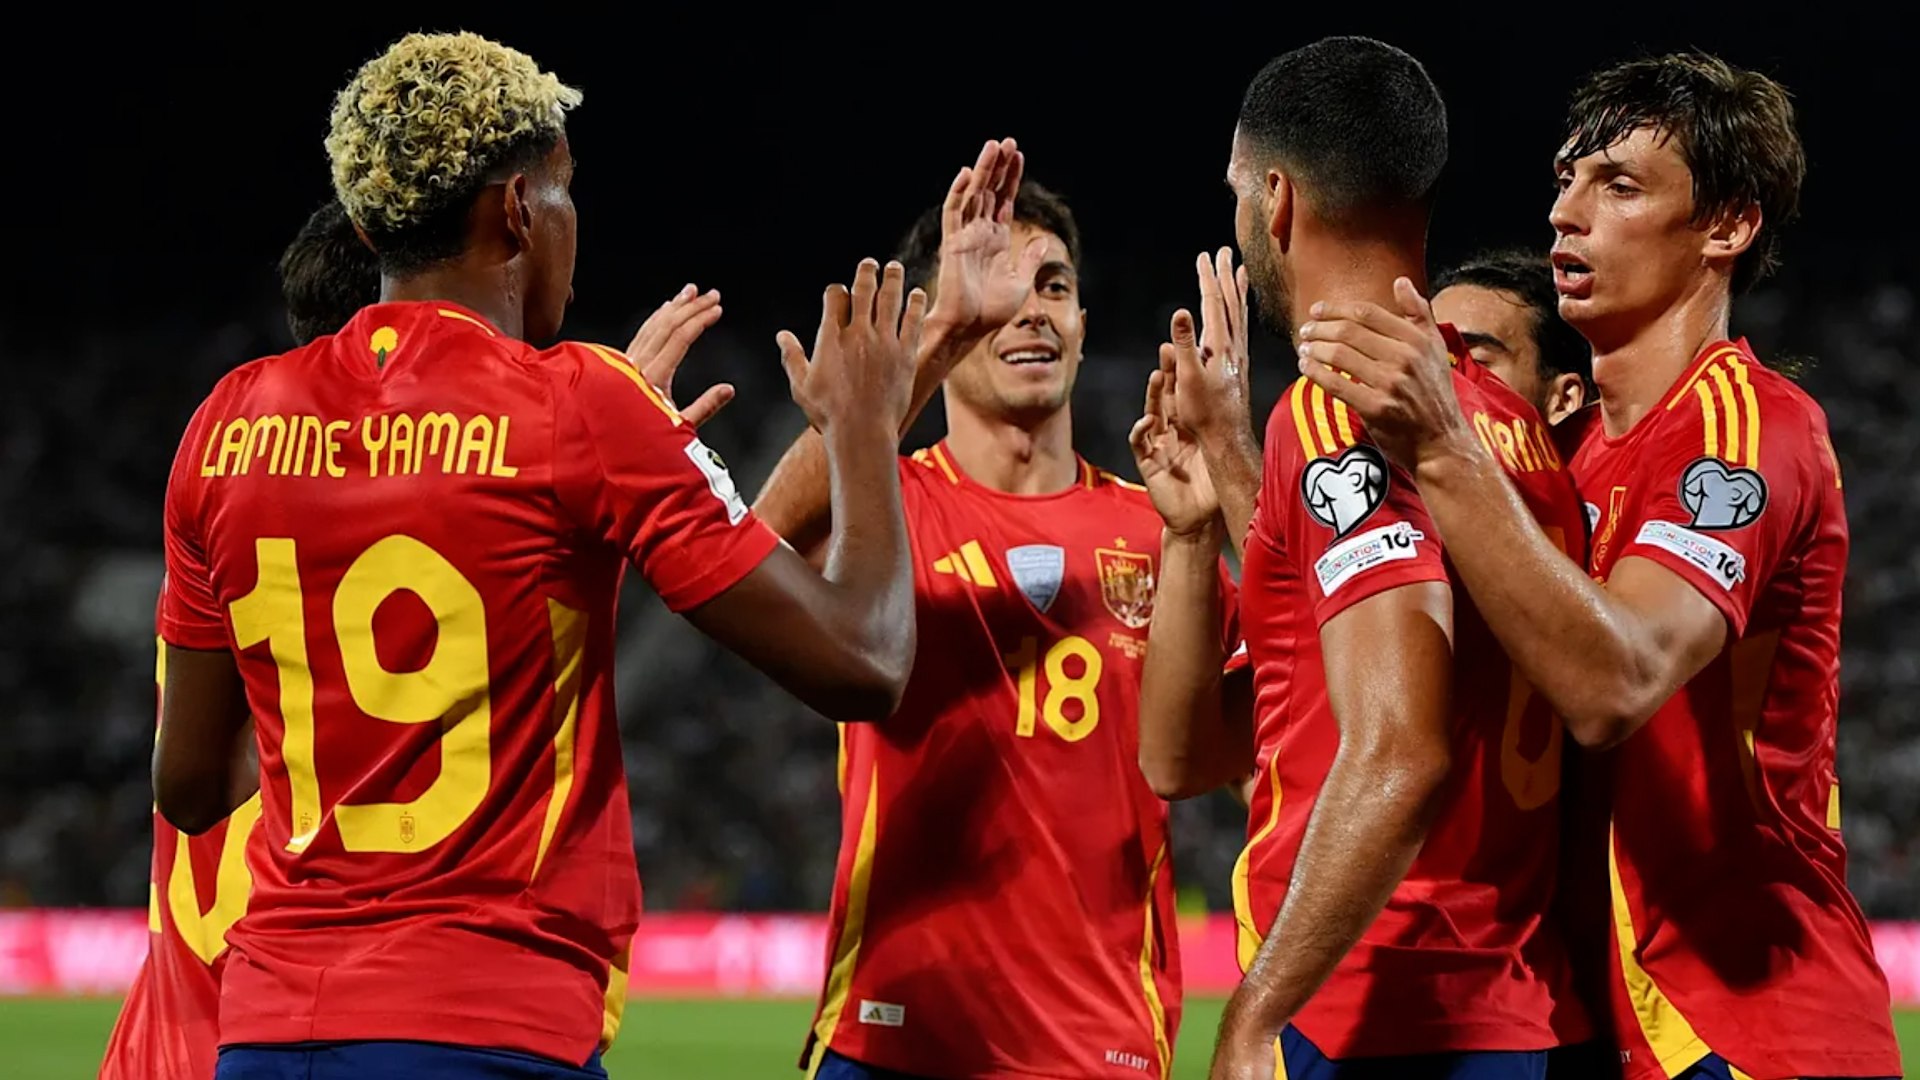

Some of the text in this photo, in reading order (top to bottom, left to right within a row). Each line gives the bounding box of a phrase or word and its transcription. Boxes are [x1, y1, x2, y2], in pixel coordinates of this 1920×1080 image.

[200, 411, 518, 478] LAMINE YAMAL
[228, 534, 492, 853] 19
[1005, 635, 1103, 742] 18
